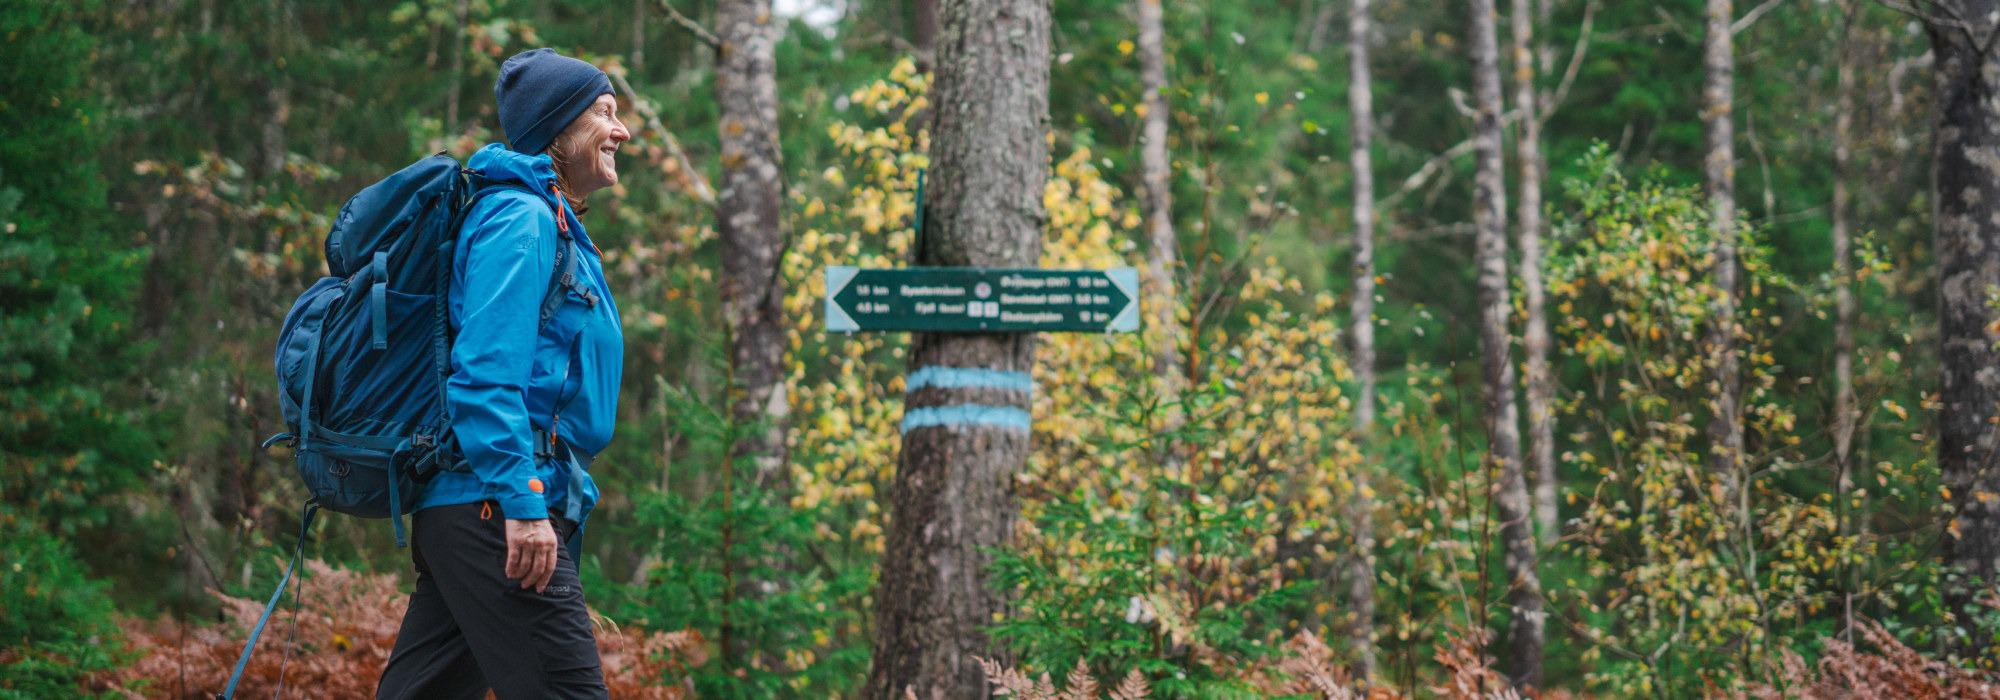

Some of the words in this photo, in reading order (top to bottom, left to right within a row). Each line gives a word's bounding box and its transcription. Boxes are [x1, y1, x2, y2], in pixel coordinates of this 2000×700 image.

[1092, 277, 1110, 288] km
[873, 285, 889, 296] km
[1092, 293, 1110, 305] km
[873, 302, 890, 314] km
